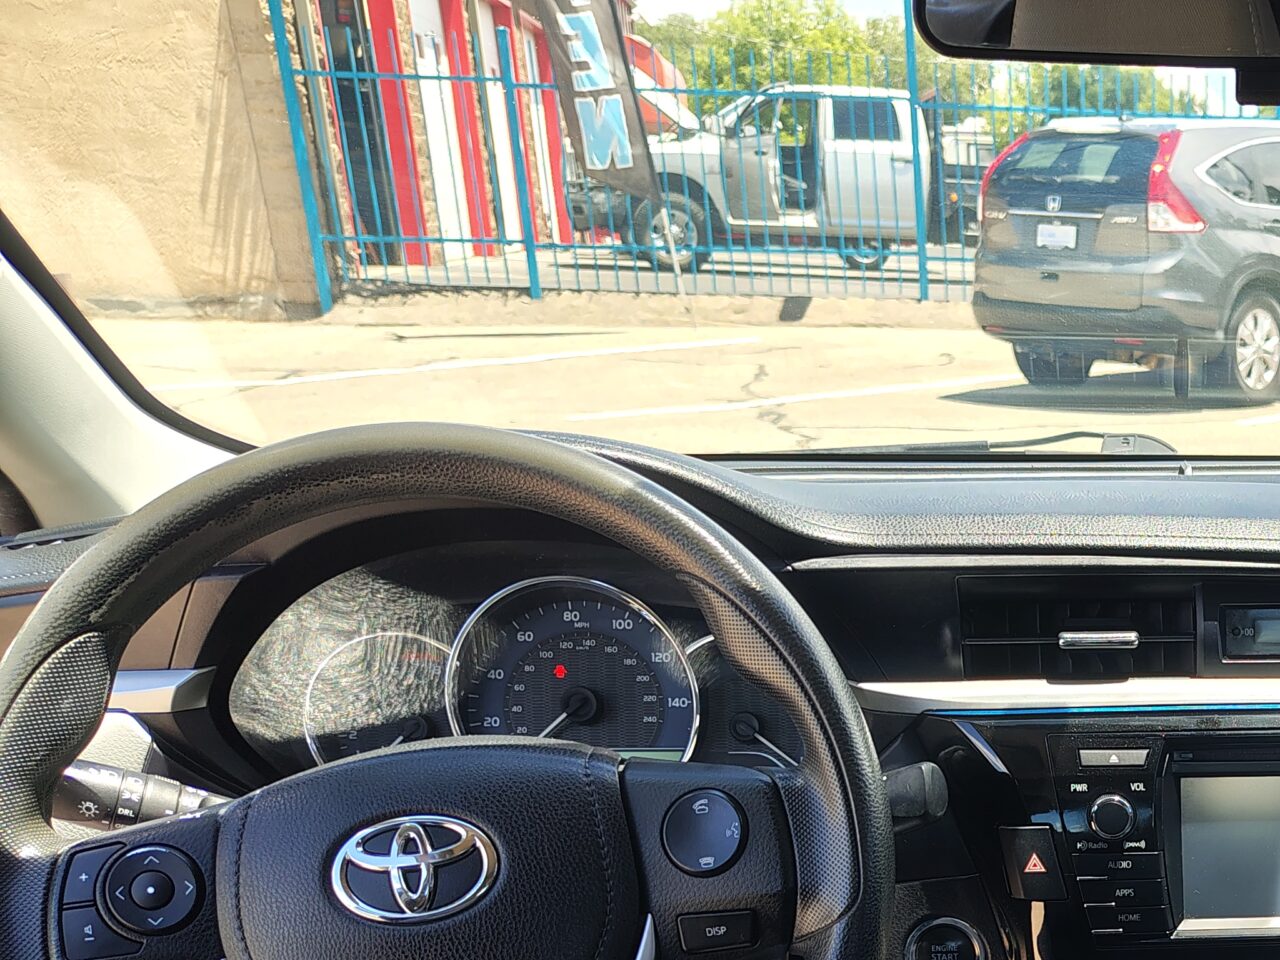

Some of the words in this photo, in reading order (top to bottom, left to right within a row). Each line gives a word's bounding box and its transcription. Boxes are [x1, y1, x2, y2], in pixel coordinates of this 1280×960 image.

[563, 611, 580, 621] 80
[612, 619, 633, 629] 100
[517, 632, 533, 641] 60
[651, 652, 671, 662] 120
[487, 669, 504, 679] 40
[668, 698, 688, 708] 140
[483, 717, 500, 727] 20
[349, 731, 357, 739] 2
[1070, 784, 1088, 792] PWR
[1130, 782, 1146, 791] VOL
[117, 807, 135, 818] DRL
[1115, 888, 1134, 896] APPS
[1118, 913, 1141, 921] HOME
[705, 926, 727, 937] DISP
[931, 944, 958, 952] ENGINE
[931, 953, 959, 960] START
